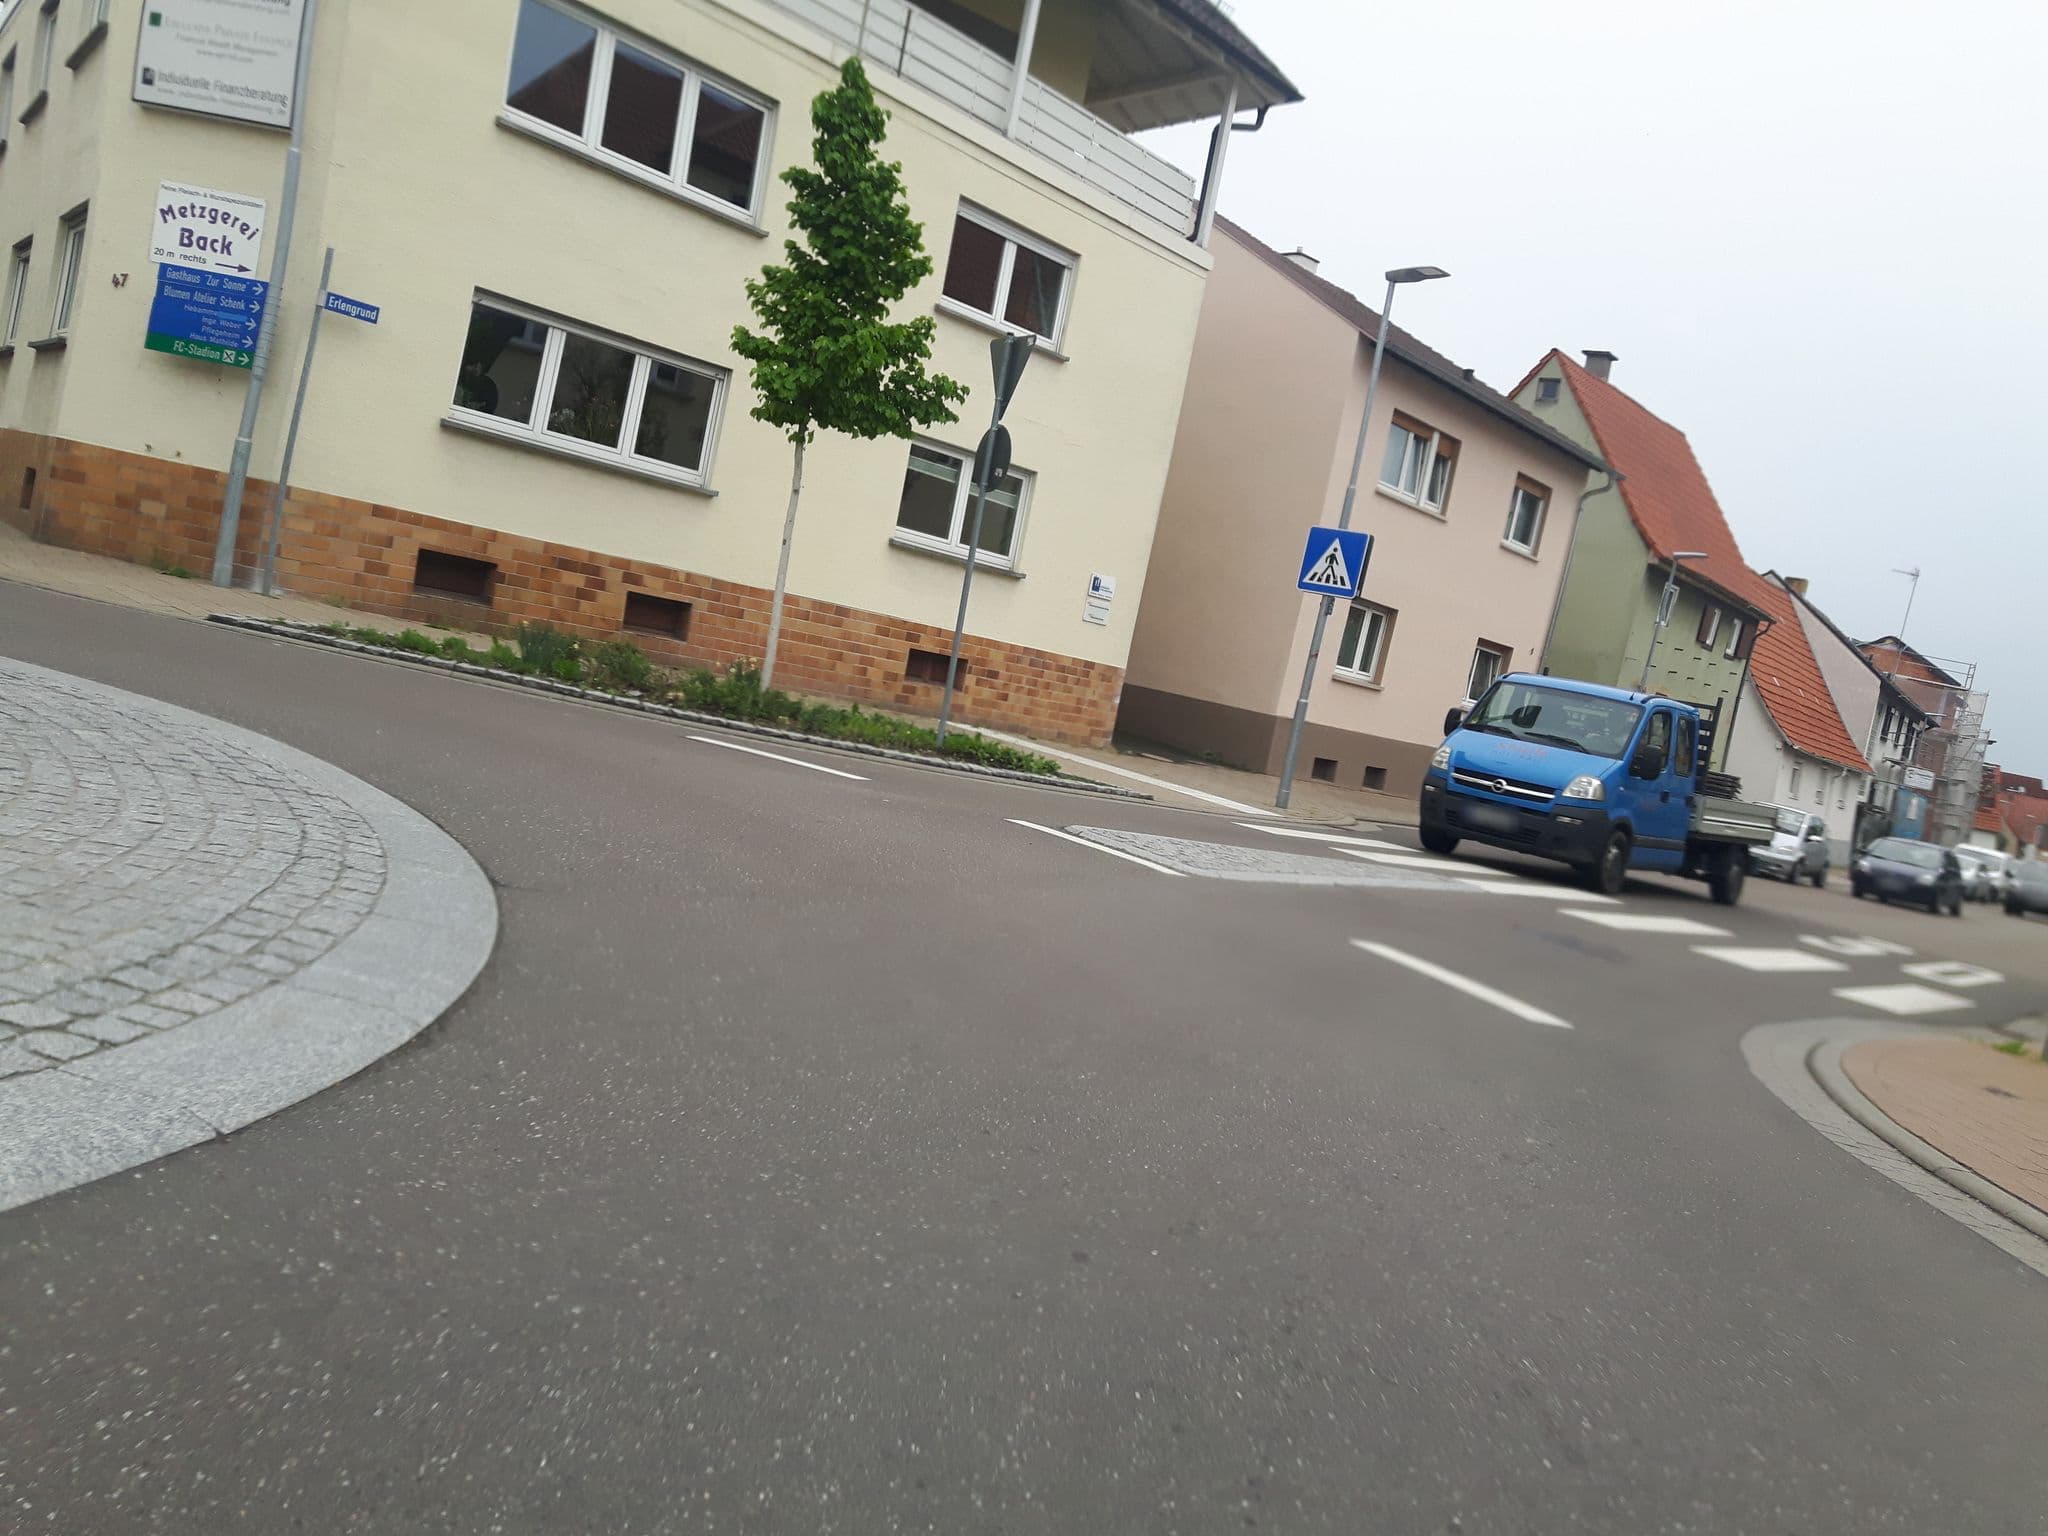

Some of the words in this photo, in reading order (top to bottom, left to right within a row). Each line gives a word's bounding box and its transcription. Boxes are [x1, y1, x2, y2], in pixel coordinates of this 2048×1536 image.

[158, 202, 259, 241] Metzgerei
[178, 227, 233, 256] Back
[153, 247, 165, 256] 20
[179, 253, 207, 265] rechts
[166, 267, 201, 284] Gasthaus
[163, 285, 191, 300] Blumen
[193, 290, 217, 304] Atelier
[220, 295, 246, 311] Schenk
[328, 295, 378, 321] Erlengrund
[173, 340, 221, 360] FC-Stadion
